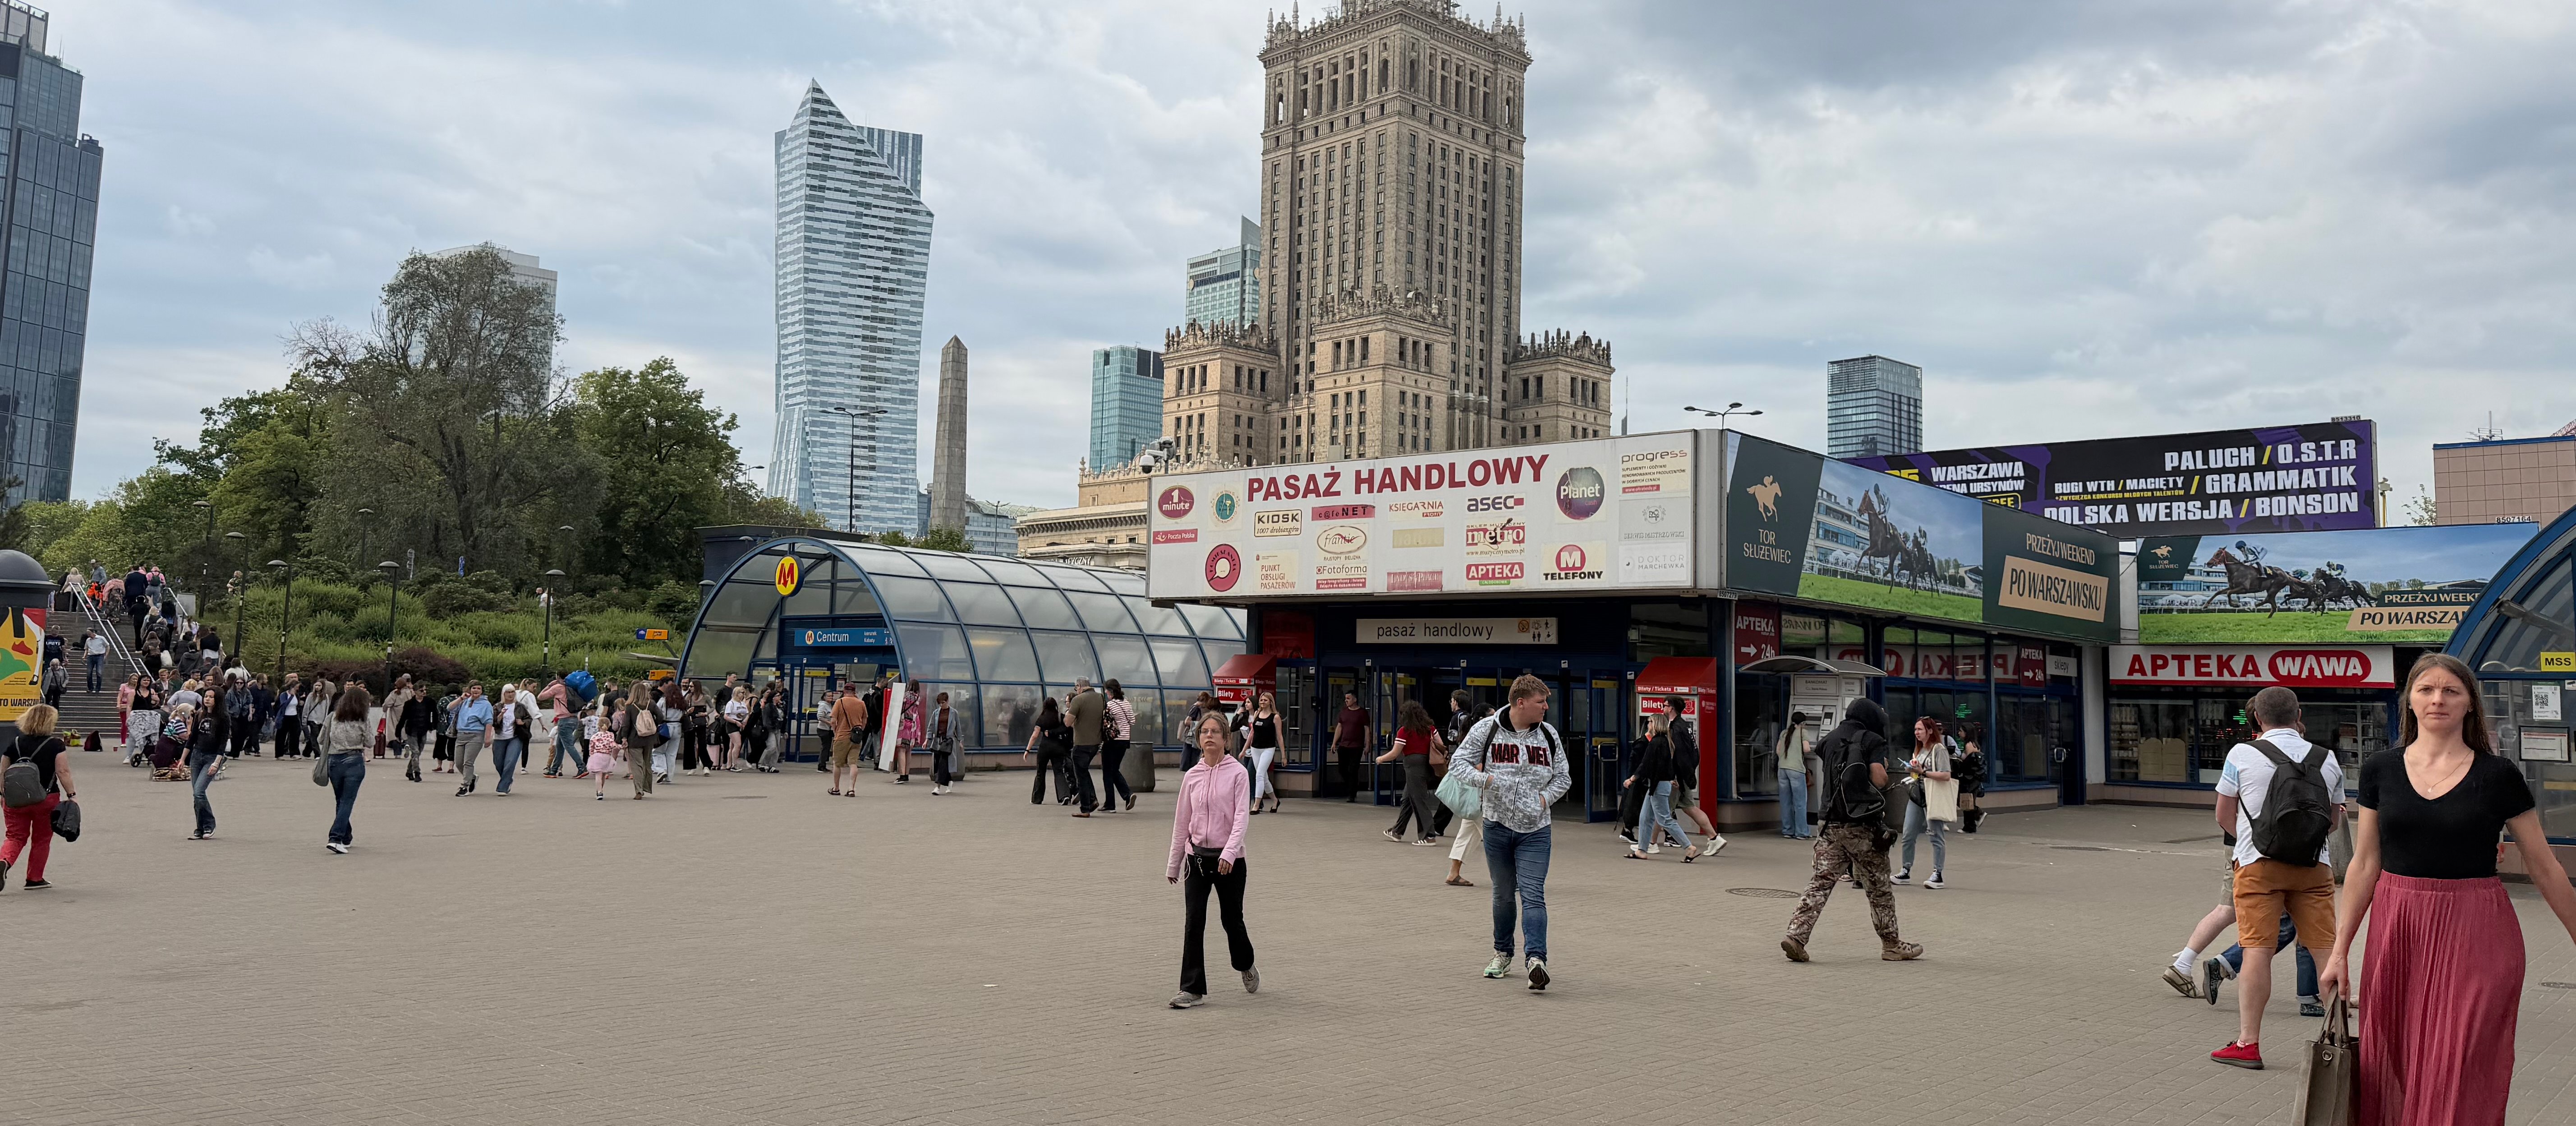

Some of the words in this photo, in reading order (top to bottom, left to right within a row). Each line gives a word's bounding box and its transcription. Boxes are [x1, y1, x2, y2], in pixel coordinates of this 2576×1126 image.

[1622, 450, 1687, 464] progress
[2165, 446, 2255, 471] PALUCH
[2278, 439, 2356, 464] O.S.T.R
[1247, 466, 1341, 502] PASAŻ
[1355, 454, 1550, 495] HANDLOWY
[1931, 461, 2024, 482] WARSZAWA
[1936, 483, 1968, 494] ENA
[1970, 479, 2025, 493] URSYNÓW
[2055, 481, 2083, 494] BUGI
[2086, 480, 2115, 492] WTH
[2126, 476, 2184, 490] MACIĘTY
[2205, 465, 2357, 494] GRAMMATIK
[1171, 489, 1178, 502] 1
[1560, 483, 1600, 499] Planet
[1163, 502, 1190, 510] minute
[1389, 501, 1443, 512] KSIĘGARNIA
[1467, 496, 1514, 512] asec
[2044, 504, 2129, 525] POLSKA
[2136, 499, 2233, 522] WERSJA
[2255, 492, 2358, 517] BONSON
[1258, 513, 1299, 524] KIOSK
[1270, 526, 1299, 535] drobiazgów
[1467, 528, 1524, 544] metro
[1758, 529, 1776, 545] TOR
[1324, 533, 1354, 547] frantic
[2026, 533, 2060, 558] PRZEŻYJ
[2060, 542, 2095, 565] WEEKEND
[1560, 551, 1581, 568] M
[1638, 555, 1684, 563] DOKTOR
[1322, 565, 1367, 574] Fotoforma
[1469, 565, 1521, 578] APTEKA
[1543, 571, 1603, 581] TELEFONY
[2010, 567, 2026, 597] PO
[2029, 571, 2102, 611] WARSZAWSKU
[2385, 592, 2437, 603] PRZEŻYJ
[1736, 616, 1775, 632] APTEKA
[2360, 611, 2384, 625] PO
[817, 631, 849, 642] Centrum
[1377, 623, 1415, 639] pasaż
[1424, 623, 1493, 640] handlowy
[1761, 644, 1775, 659] 24h
[2021, 648, 2043, 660] APTEKA
[2054, 658, 2069, 674] sklepy
[2127, 653, 2262, 677] APTEKA
[2276, 654, 2364, 679] WAWA
[2545, 657, 2571, 666] MSS
[1218, 690, 1234, 699] Bilety
[1642, 700, 1664, 711] Bilety
